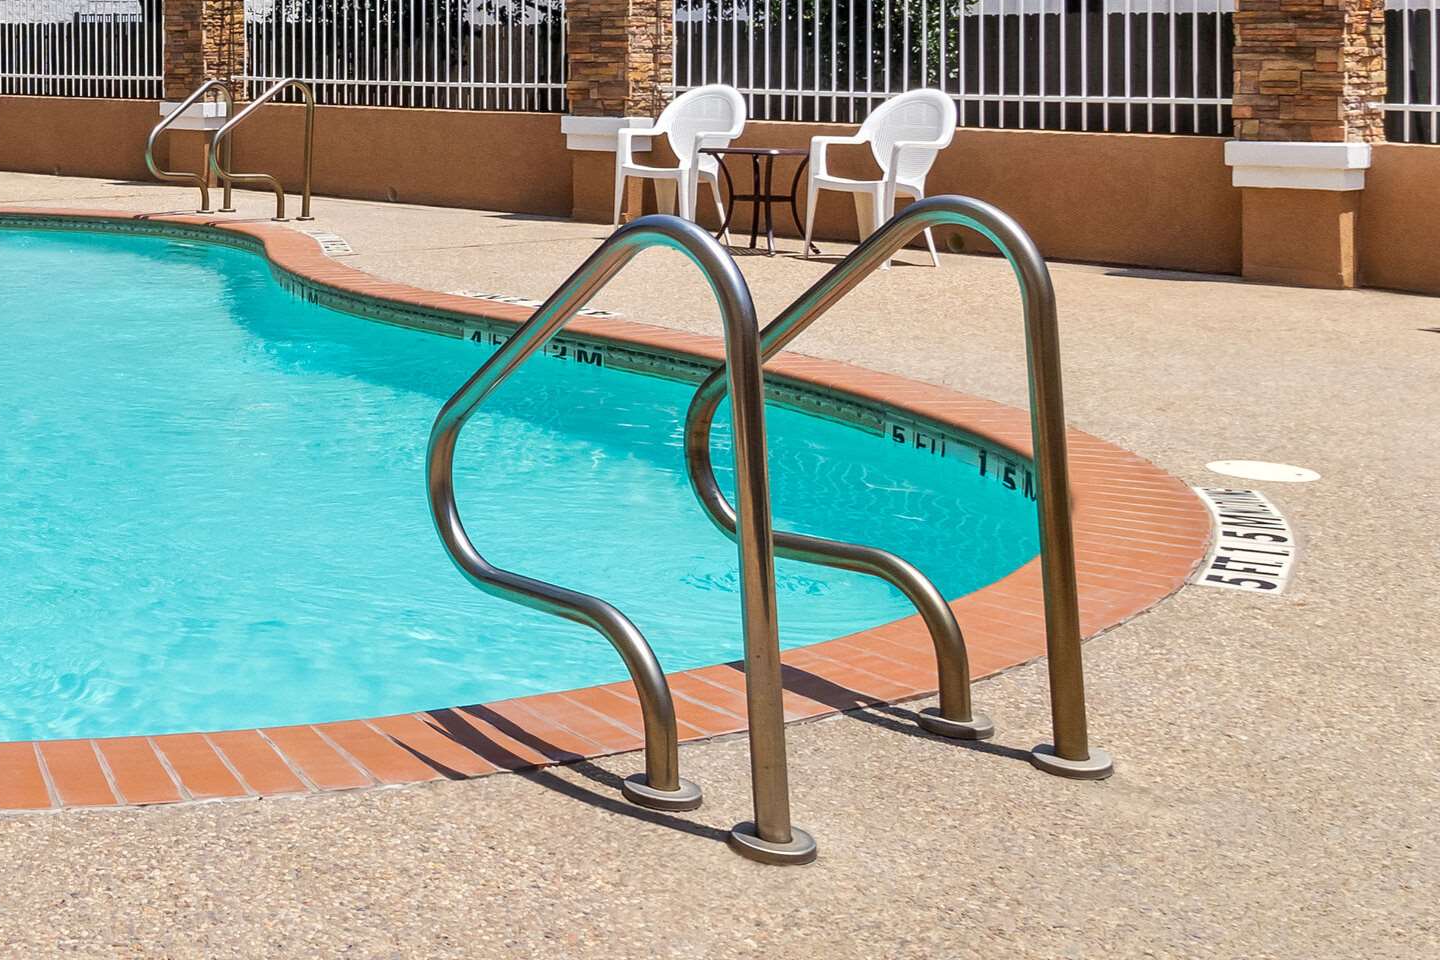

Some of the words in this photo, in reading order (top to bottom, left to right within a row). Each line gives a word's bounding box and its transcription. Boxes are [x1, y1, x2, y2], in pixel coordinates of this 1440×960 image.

[577, 349, 602, 367] M
[893, 424, 905, 444] 5
[1205, 574, 1278, 590] 5
